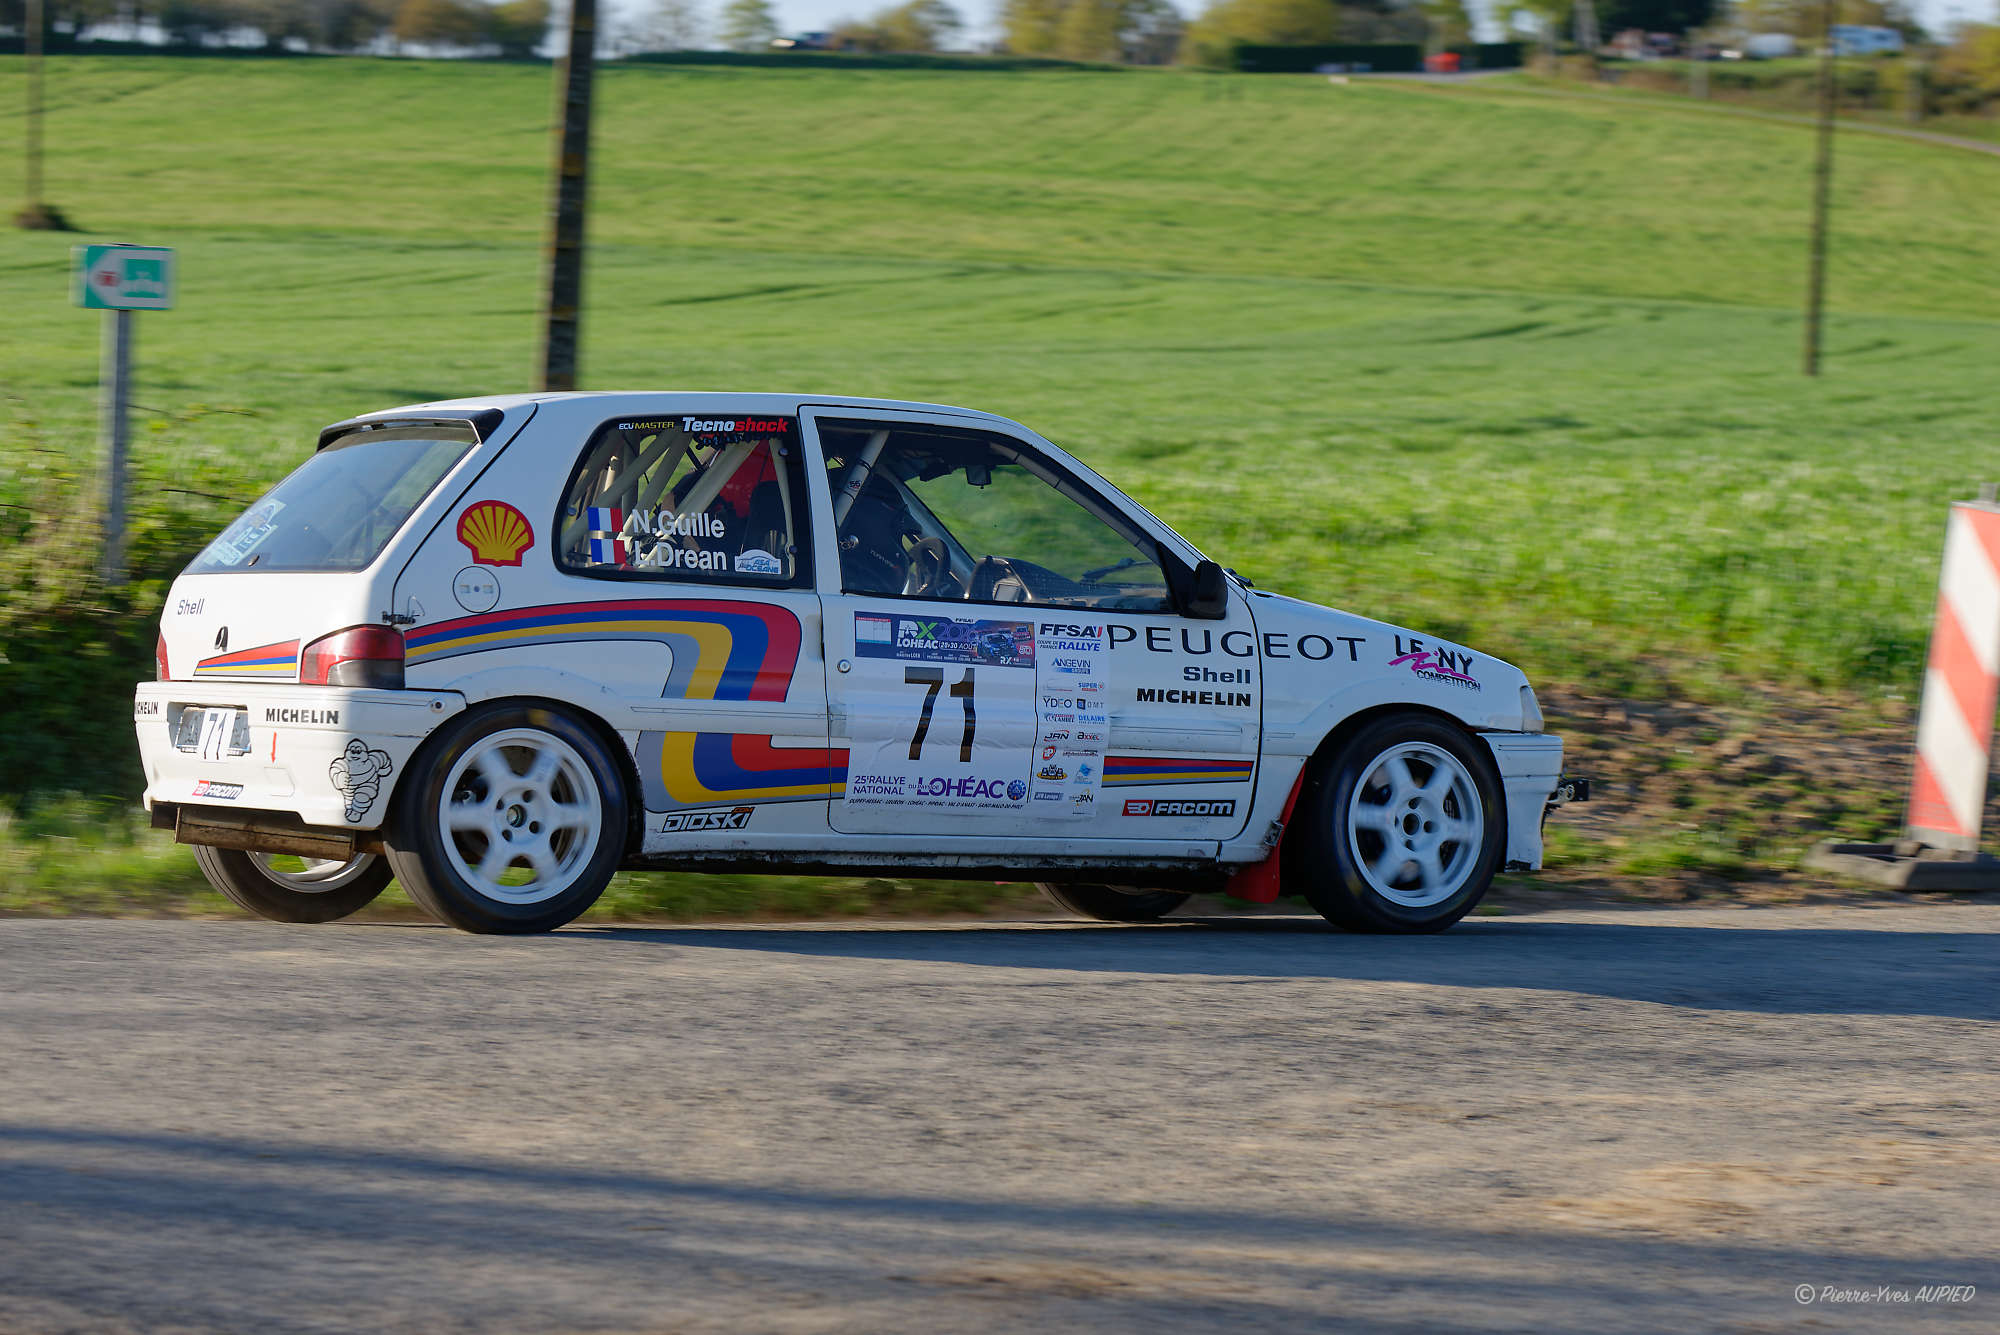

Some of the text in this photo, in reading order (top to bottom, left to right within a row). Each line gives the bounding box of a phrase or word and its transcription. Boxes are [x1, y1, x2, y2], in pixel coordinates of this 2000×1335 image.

[682, 416, 789, 432] Tecnoshock
[631, 508, 726, 538] N.Guille
[634, 540, 727, 571] L.Drean
[177, 598, 205, 616] Shell
[1040, 623, 1096, 638] FFSA
[896, 638, 939, 650] LOHEAC
[1058, 641, 1101, 652] RALLYE
[1106, 624, 1366, 661] PEUGEOT
[1051, 657, 1091, 668] ANGEVIN
[1437, 646, 1473, 675] NY
[1183, 666, 1251, 684] Shell
[1416, 669, 1481, 692] COMPETITION
[1136, 688, 1251, 707] MICHELIN
[266, 708, 339, 724] MICHELIN
[904, 666, 976, 763] 71
[203, 711, 228, 760] 71
[869, 775, 906, 786] RALLYE
[916, 775, 1006, 799] LOHÉAC
[852, 785, 905, 796] NATIONAL
[1155, 802, 1233, 815] FACOM
[663, 812, 751, 832] DIOSKI
